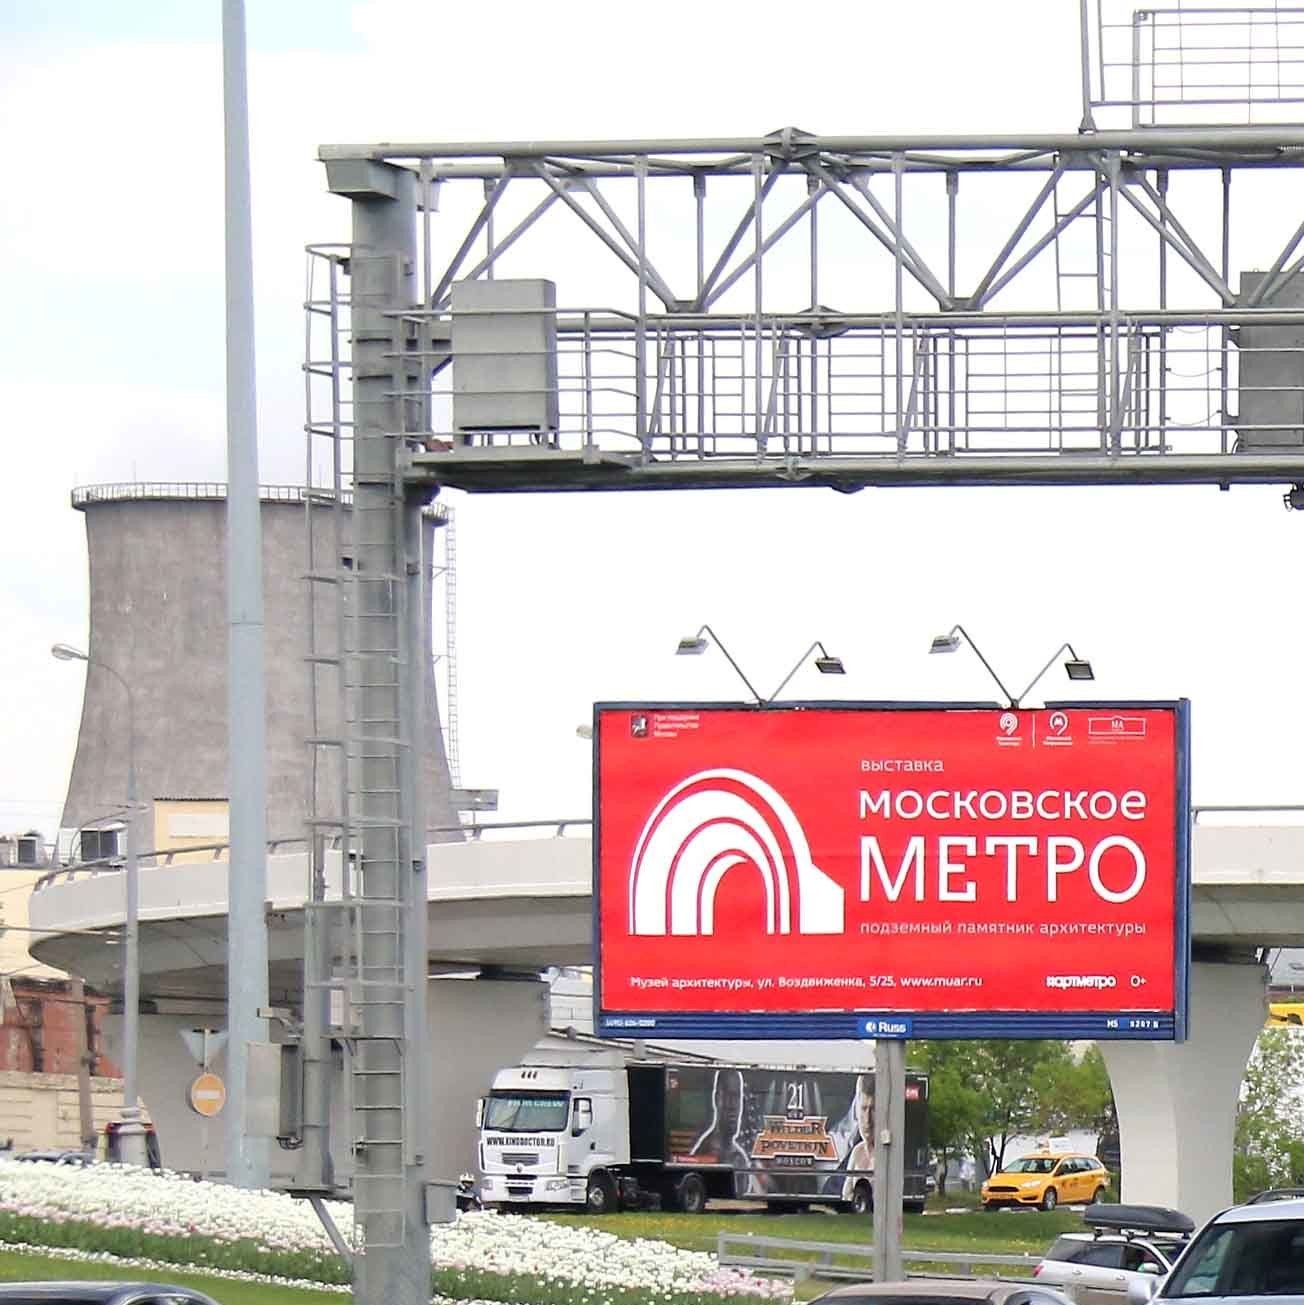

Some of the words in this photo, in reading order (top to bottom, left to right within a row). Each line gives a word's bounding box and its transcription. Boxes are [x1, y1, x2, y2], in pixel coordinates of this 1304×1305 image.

[861, 759, 944, 772] выставка
[860, 835, 1147, 903] МЕТРО
[860, 921, 951, 935] подземный
[957, 923, 1034, 934] памятник
[1039, 923, 1146, 936] архитектуры
[631, 976, 668, 989] Музей
[757, 980, 774, 990] ул.
[900, 976, 983, 987] www.muar.ru
[1130, 975, 1146, 987] 0+
[878, 1022, 907, 1033] Russ
[787, 1083, 804, 1110] 21
